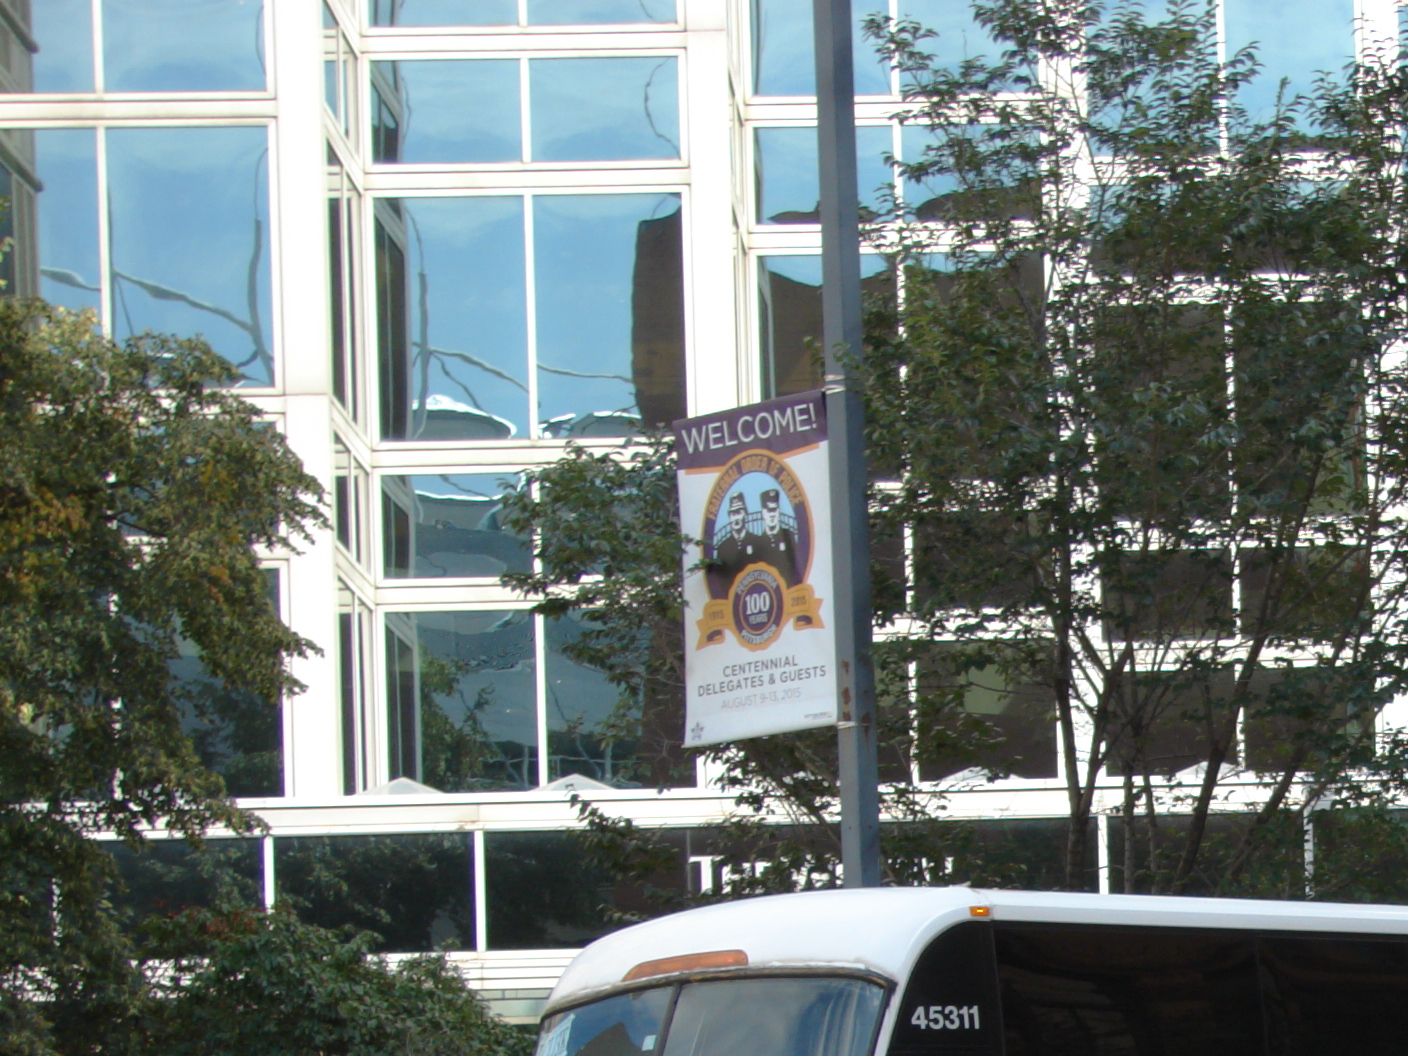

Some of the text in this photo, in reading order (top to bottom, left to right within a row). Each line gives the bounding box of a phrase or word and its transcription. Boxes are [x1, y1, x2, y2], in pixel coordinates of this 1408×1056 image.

[681, 402, 817, 454] WELCOME!
[744, 592, 771, 615] 100
[723, 655, 799, 678] CENTENNIAL
[697, 665, 827, 697] DELEGATES & GUESTS
[721, 694, 757, 709] AUGUST
[781, 687, 801, 700] 2015
[911, 1005, 980, 1030] 45311
